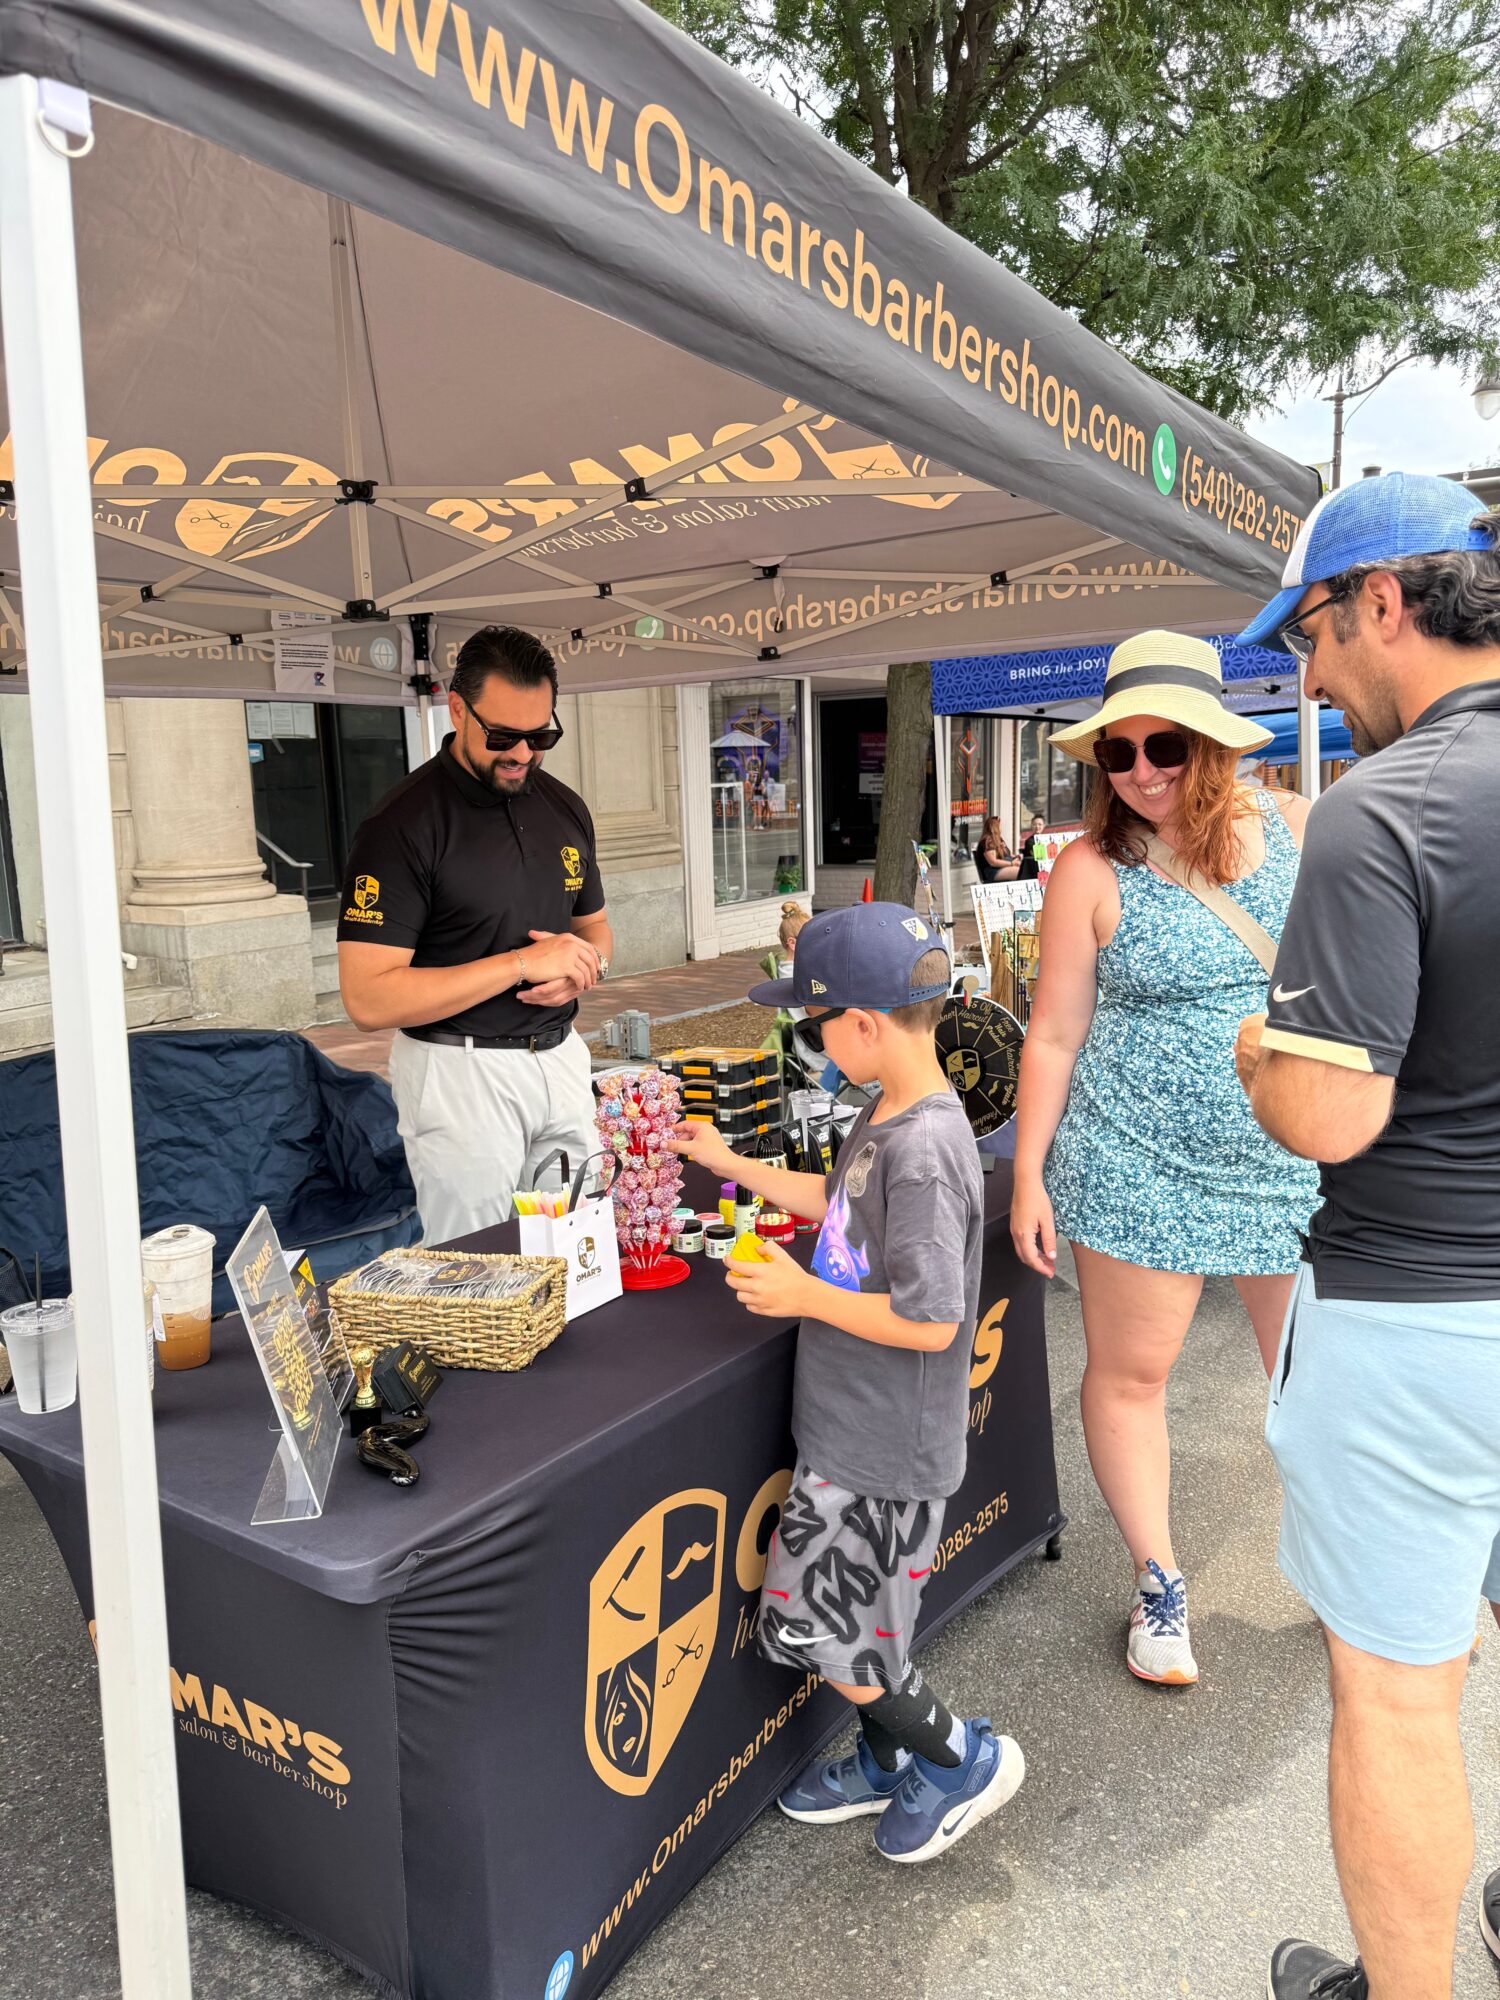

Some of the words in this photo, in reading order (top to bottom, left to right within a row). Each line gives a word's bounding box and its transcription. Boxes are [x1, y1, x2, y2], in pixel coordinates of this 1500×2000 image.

[1181, 446, 1306, 553] (540)282-257
[1009, 666, 1052, 681] BRING
[1054, 662, 1074, 675] the
[1075, 657, 1107, 672] JOY!
[958, 1009, 990, 1023] Haircut
[575, 1264, 602, 1283] OMAR'S
[170, 1666, 351, 1786] MAR'S
[179, 1716, 218, 1745] salon
[222, 1730, 238, 1751] &
[242, 1736, 348, 1810] barbershop
